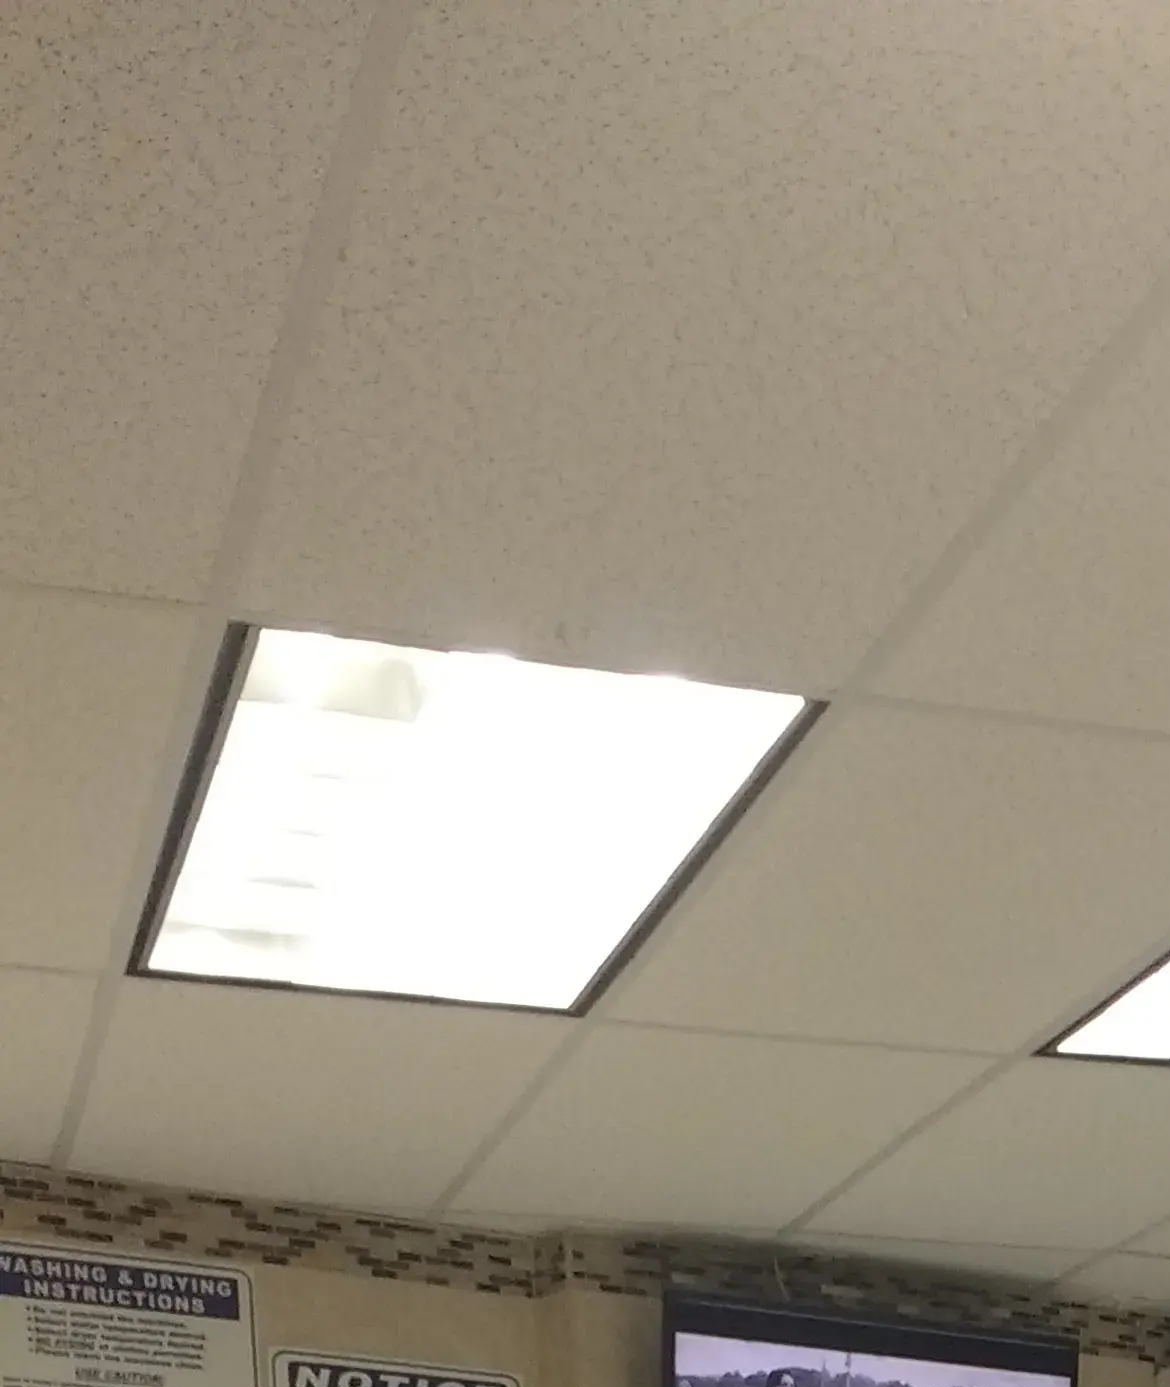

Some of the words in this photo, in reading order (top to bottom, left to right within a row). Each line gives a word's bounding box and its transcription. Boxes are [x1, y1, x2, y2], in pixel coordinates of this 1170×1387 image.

[23, 1279, 205, 1314] INSTRUCTIONS
[118, 1270, 133, 1286] &
[143, 1273, 232, 1298] DRYING
